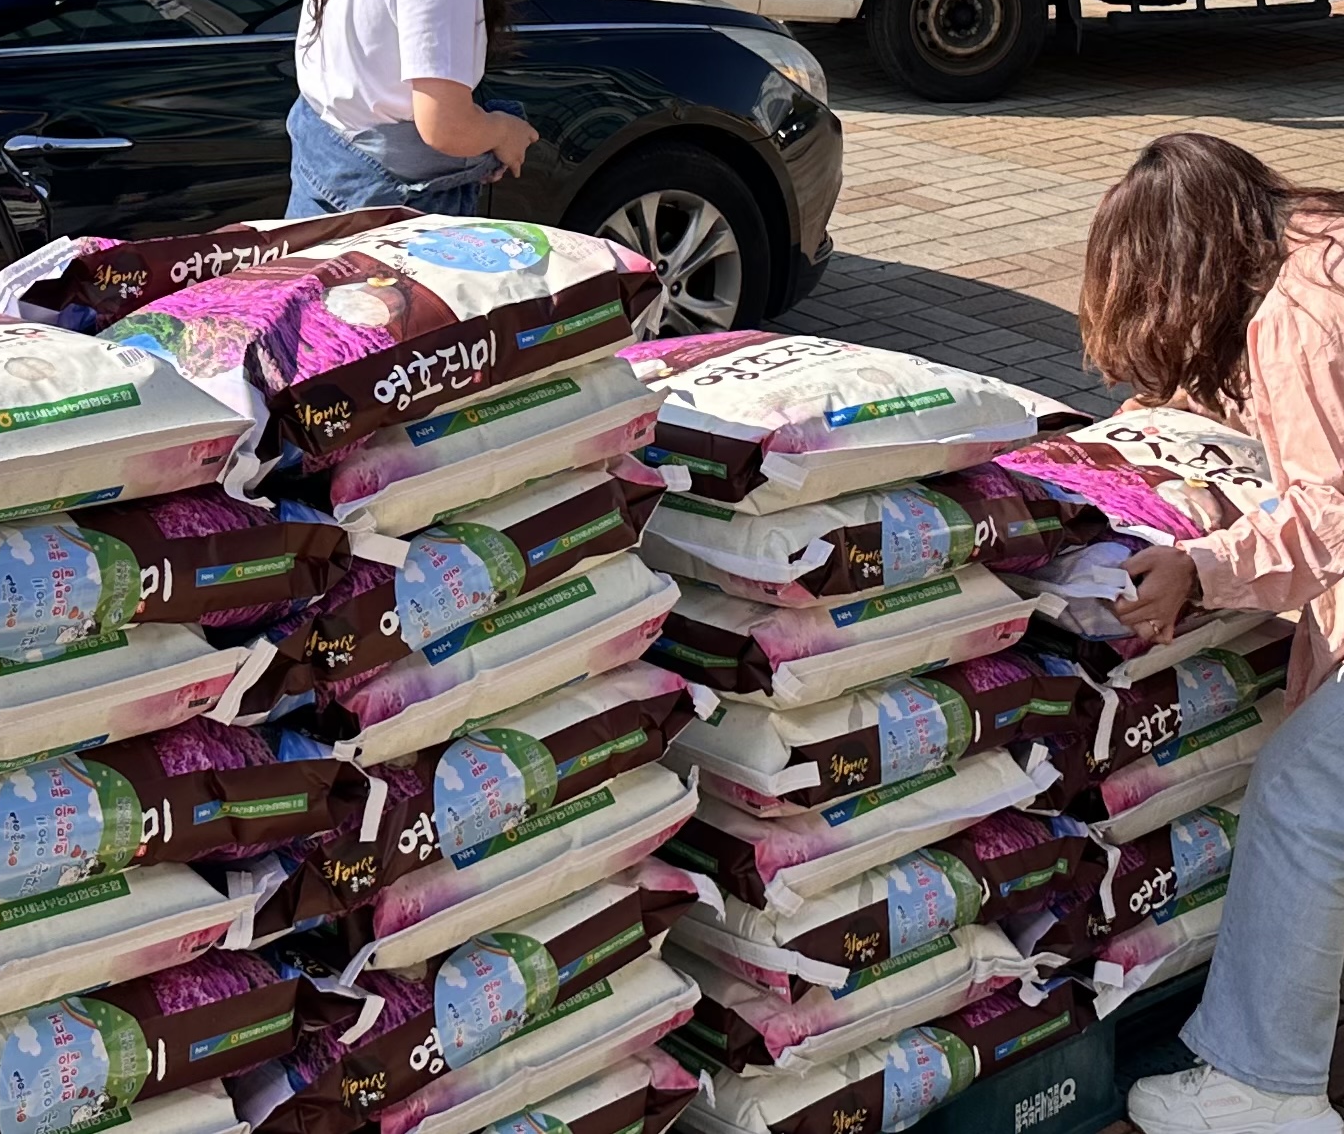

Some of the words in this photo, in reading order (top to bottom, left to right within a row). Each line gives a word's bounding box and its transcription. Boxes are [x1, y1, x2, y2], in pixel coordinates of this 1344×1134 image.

[94, 265, 148, 291] 황매산
[374, 330, 497, 411] 영호진미
[294, 401, 351, 432] 황매산
[417, 425, 436, 438] NH
[51, 568, 76, 617] 희망을
[442, 566, 469, 610] 희망을
[836, 610, 853, 621] NH
[431, 641, 452, 656] NH
[1157, 750, 1170, 761] NH
[481, 775, 501, 820] 희망을
[53, 805, 77, 856] 희망을
[828, 808, 846, 822] NH
[456, 847, 477, 862] NH
[323, 856, 377, 887] 황매산
[1, 880, 122, 922] 합천새남부농업협동조합
[484, 979, 503, 1026] 희망을
[58, 1050, 81, 1102] 희망을
